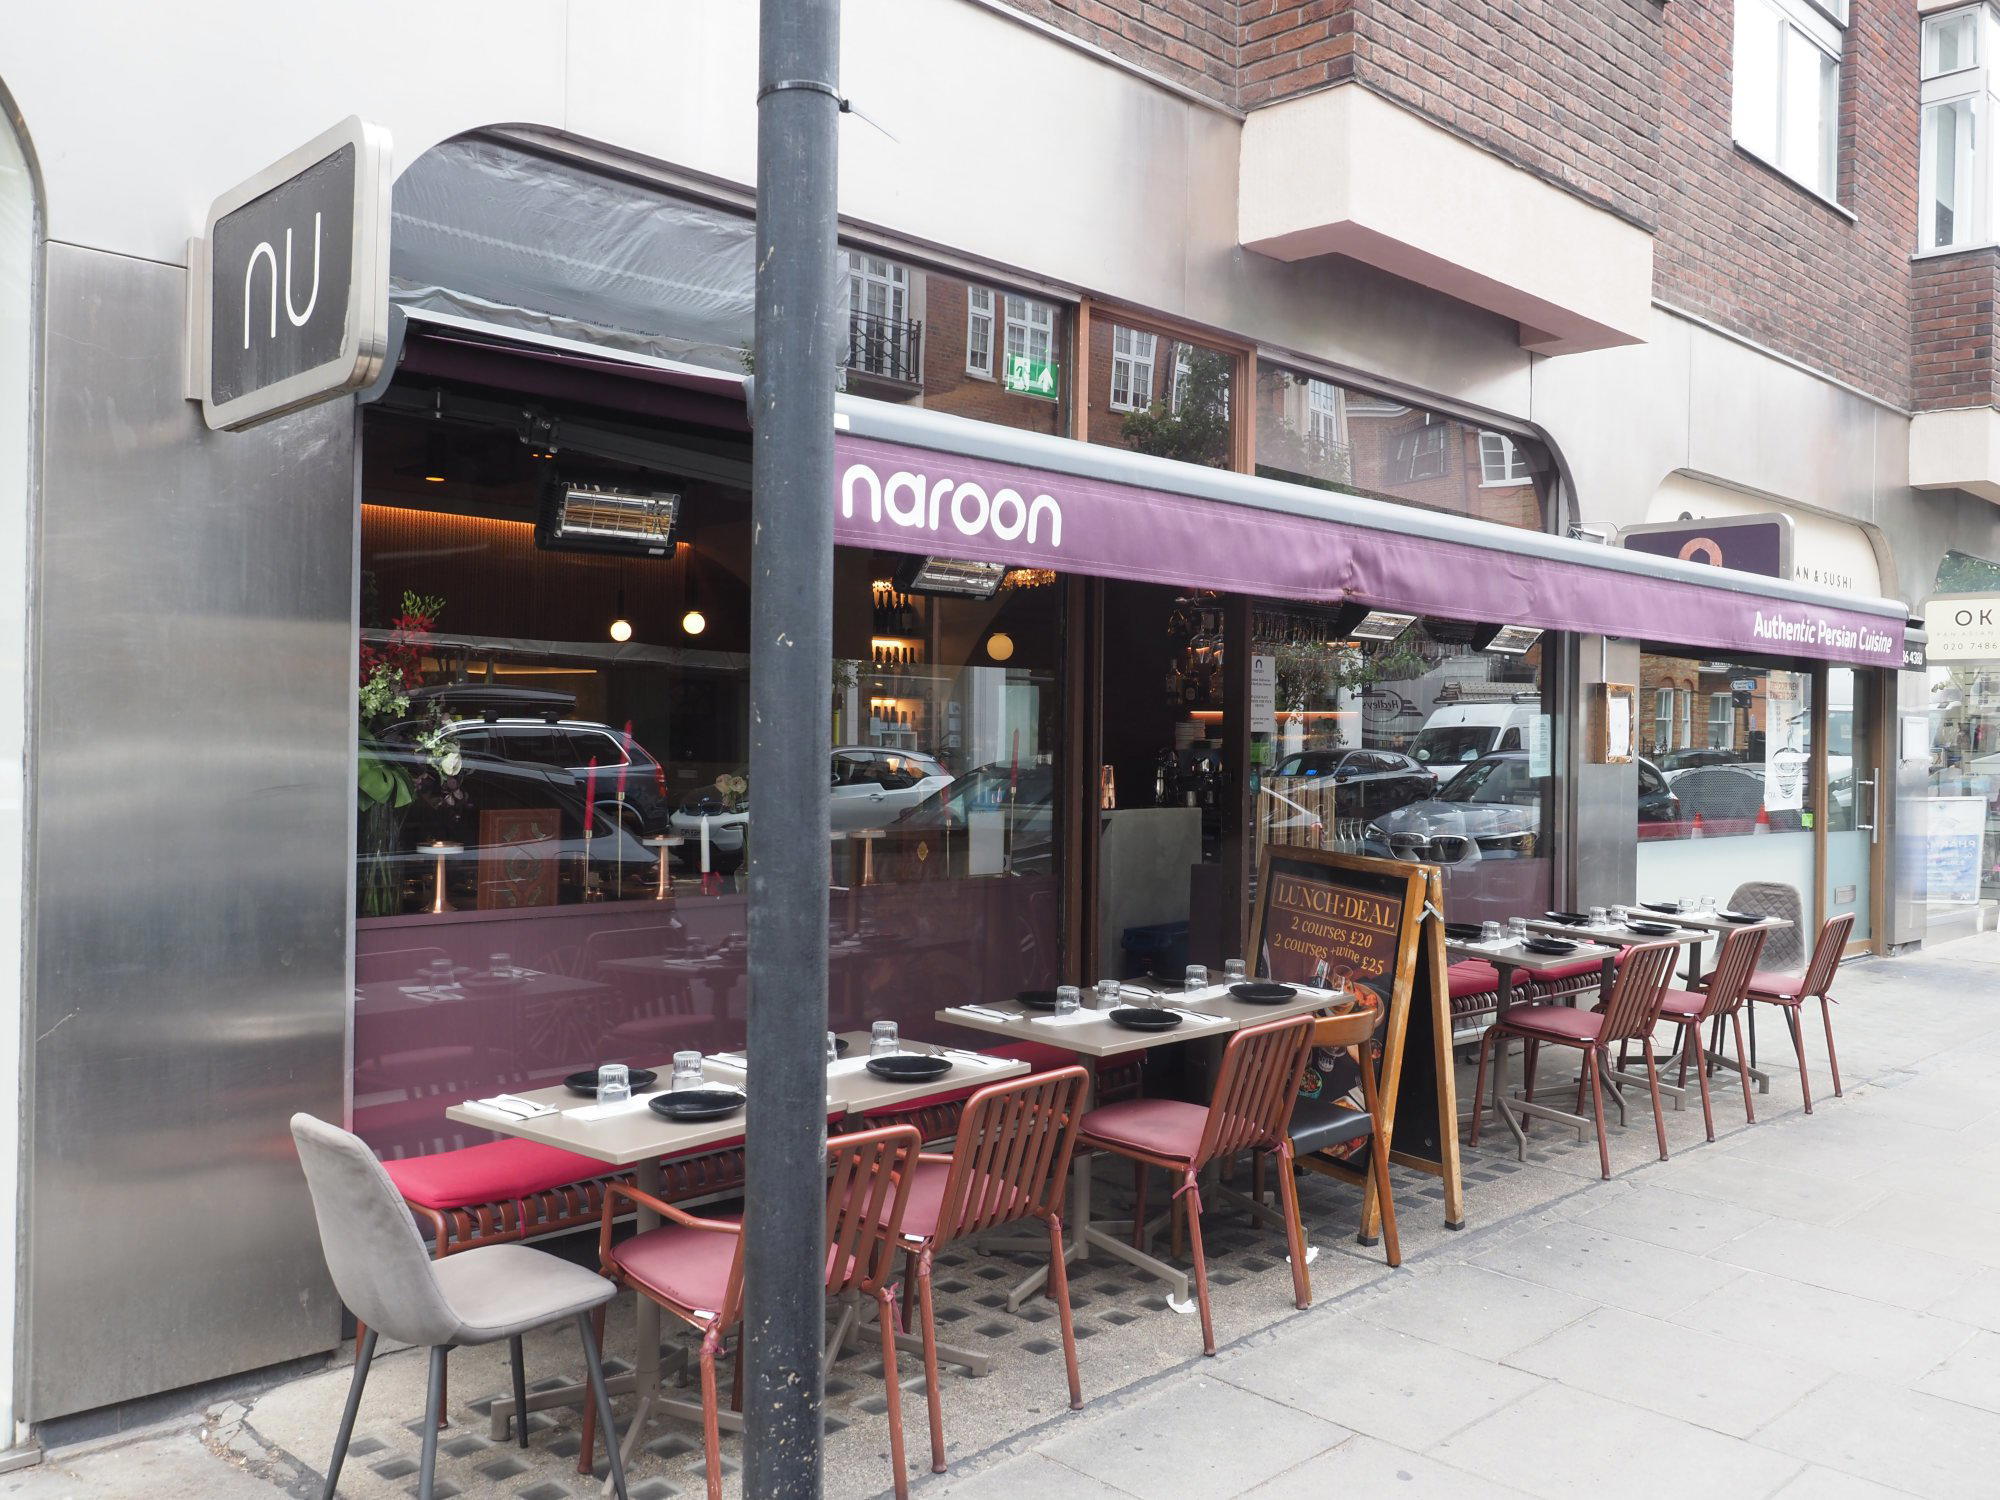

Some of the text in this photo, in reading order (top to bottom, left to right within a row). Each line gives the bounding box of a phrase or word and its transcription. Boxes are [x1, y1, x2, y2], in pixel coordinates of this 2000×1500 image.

[244, 212, 321, 349] nu
[842, 464, 1062, 547] naroon
[1813, 570, 1819, 582] &
[1823, 572, 1853, 589] SUSHI
[1753, 611, 1893, 654] Authentic Persian Cuisine
[1943, 642, 1998, 651] 020 7486
[1291, 915, 1373, 949] 2 courses £20
[1273, 933, 1385, 977] 2 courses +wine £25
